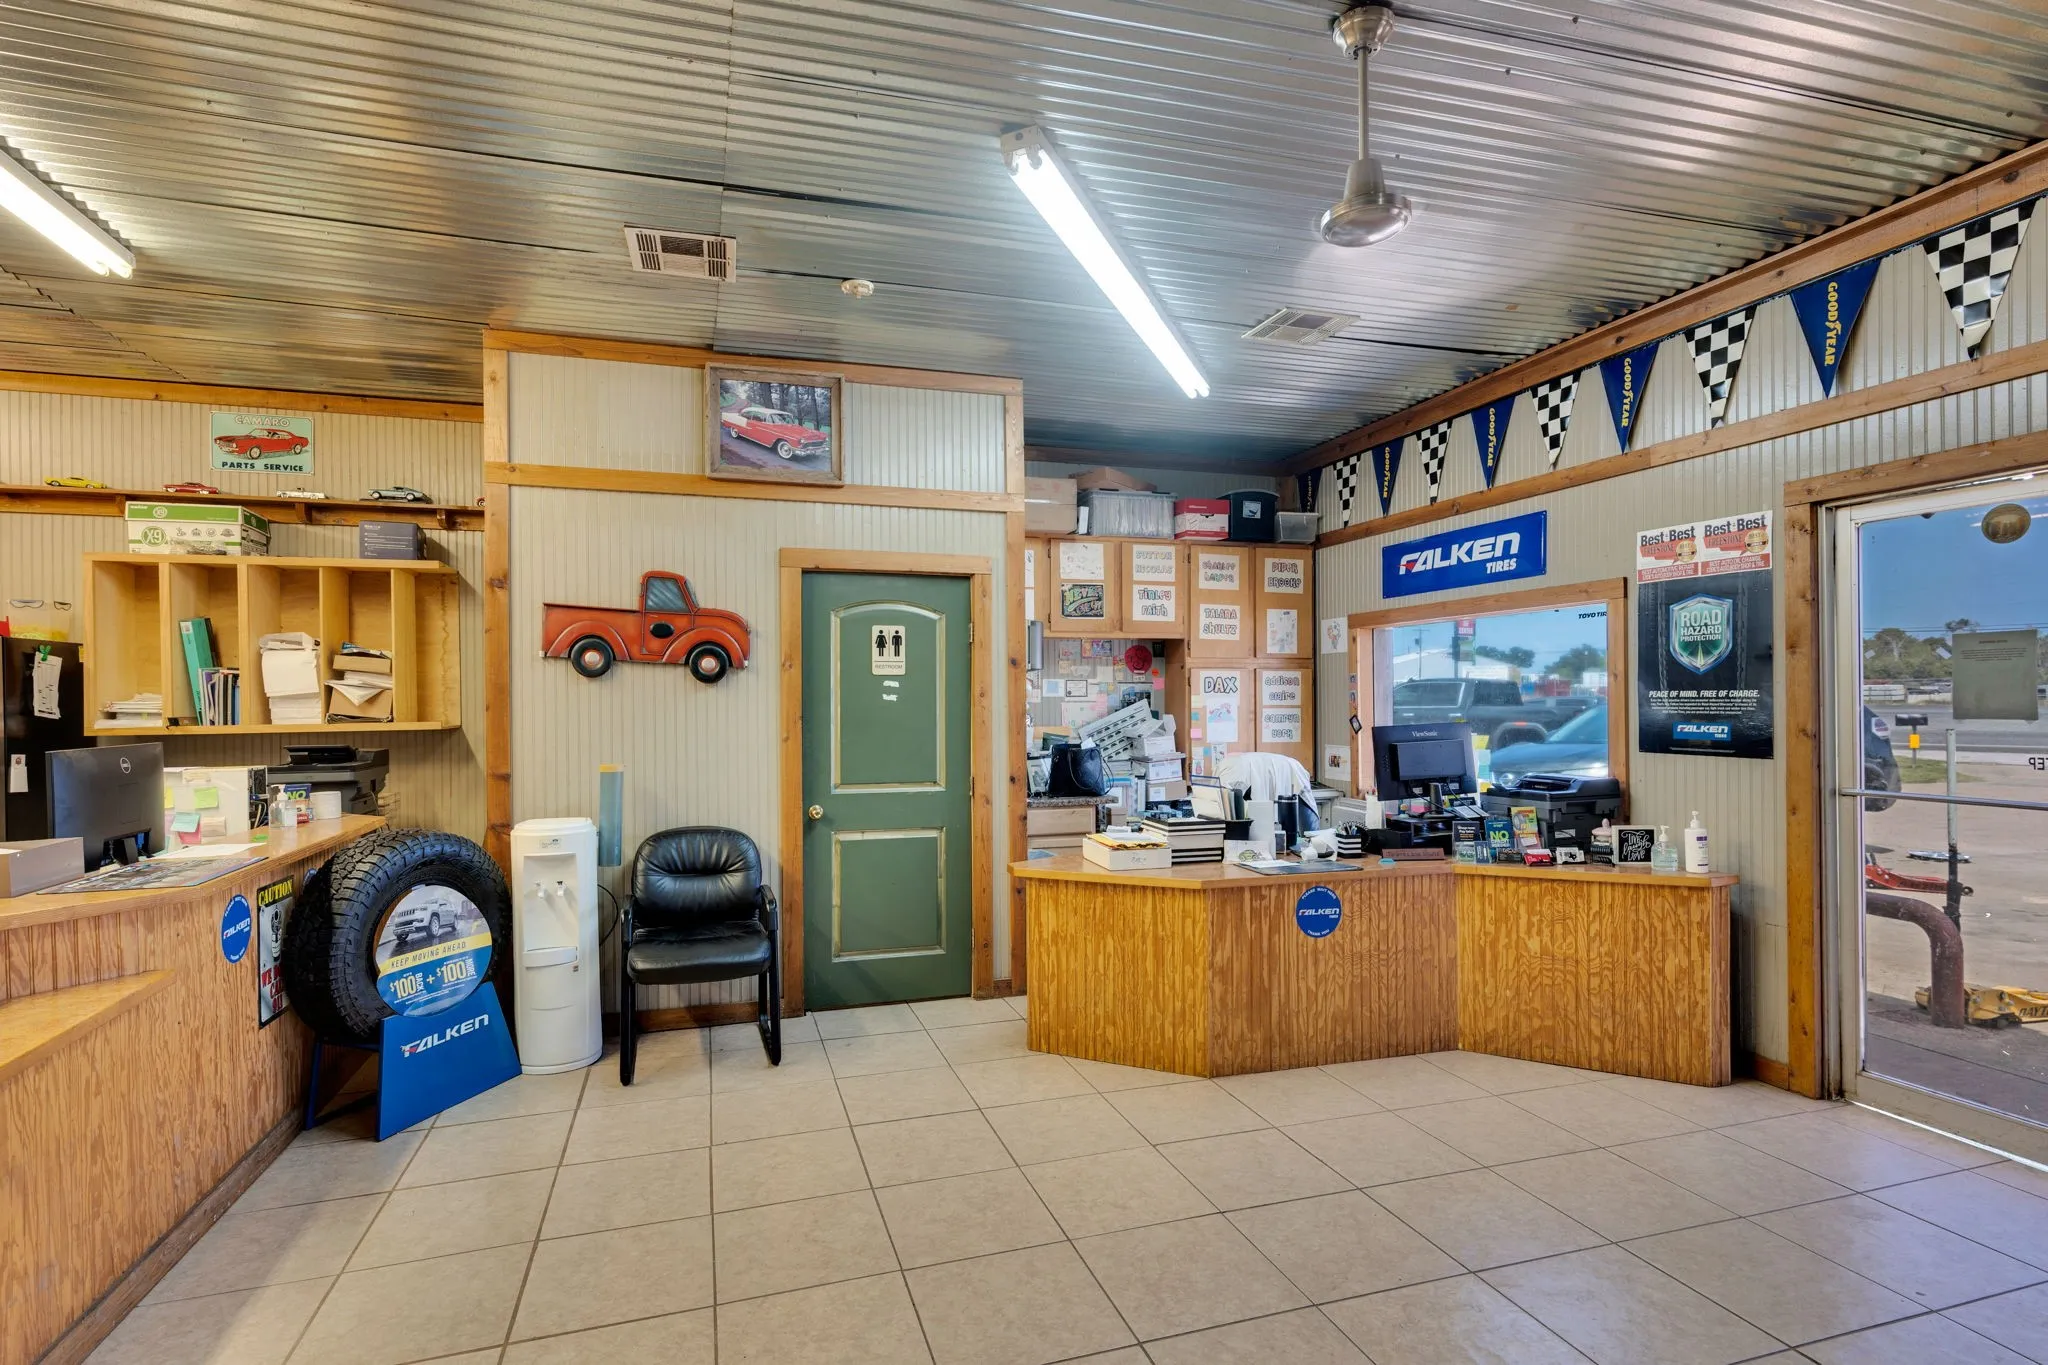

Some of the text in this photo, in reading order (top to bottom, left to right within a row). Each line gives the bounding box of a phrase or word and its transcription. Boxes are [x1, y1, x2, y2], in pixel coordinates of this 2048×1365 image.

[1825, 282, 1841, 366] GOODYEAR
[1622, 358, 1634, 428] GOODYEAR
[235, 415, 290, 427] CAMARO
[1487, 407, 1497, 467] GOODYEAR
[222, 461, 304, 472] PARTS SERVICE
[1383, 447, 1391, 498] GOODYEAR
[1705, 515, 1766, 536] Best Best
[145, 529, 162, 545] X9
[1640, 526, 1696, 547] Best Best
[1398, 532, 1521, 575] FALKEN
[1486, 558, 1517, 574] TIRES
[1681, 610, 1722, 627] ROAD
[1680, 634, 1721, 642] PROTECTION
[1681, 625, 1722, 636] HAZARD
[1203, 676, 1239, 694] DAX
[1649, 690, 1669, 698] PEACE
[1669, 690, 1679, 698] OF
[1679, 690, 1699, 698] MIND.
[1700, 690, 1717, 698] FREE
[1729, 689, 1760, 697] CHARGE.
[1677, 725, 1728, 733] FALKEN
[287, 790, 307, 800] NO
[1489, 830, 1510, 840] NO
[258, 879, 293, 906] CAUTION
[1299, 908, 1340, 916] FALKEN
[223, 917, 251, 940] FALKEN
[391, 957, 410, 969] KEEP
[412, 948, 440, 962] MOVING
[442, 941, 466, 954] AHEAD
[436, 958, 477, 983] $100 MORE
[389, 975, 417, 999] $100
[415, 972, 425, 992] BACK
[400, 1014, 489, 1058] FALKEN
